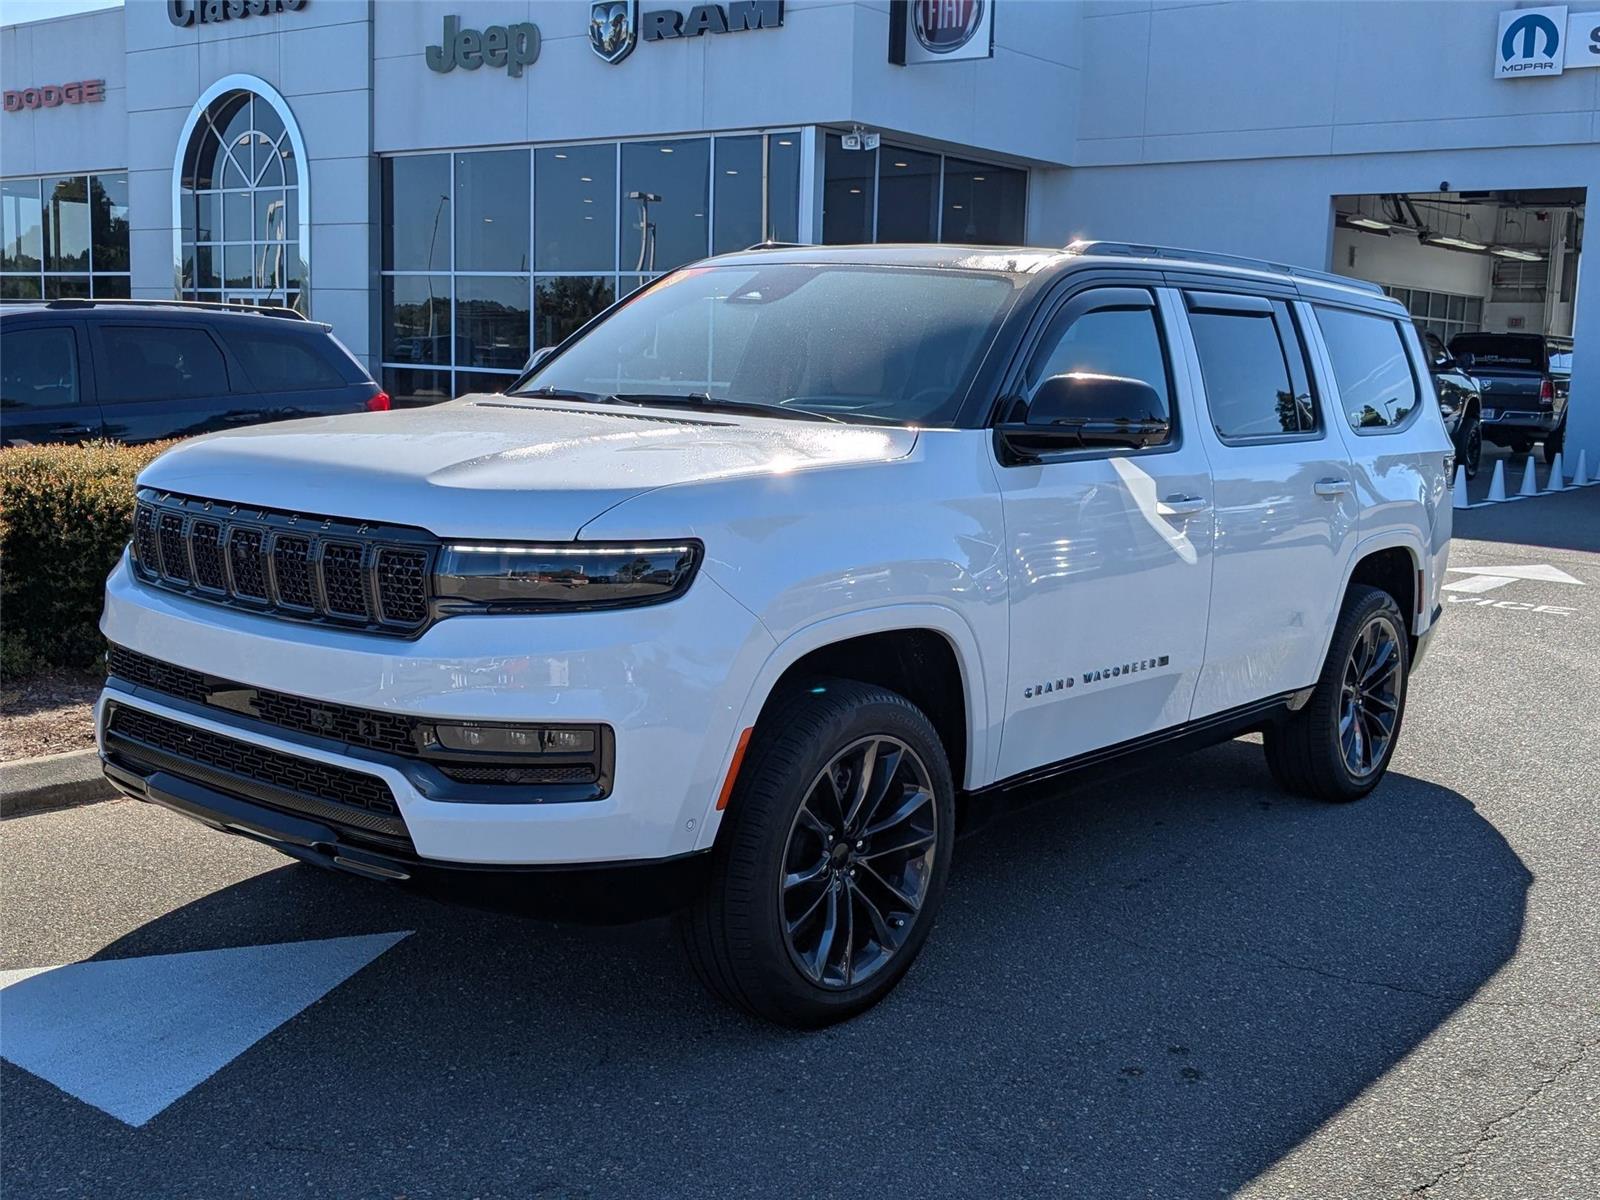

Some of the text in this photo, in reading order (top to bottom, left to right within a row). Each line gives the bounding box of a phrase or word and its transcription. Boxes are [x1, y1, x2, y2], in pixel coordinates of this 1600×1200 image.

[643, 1, 784, 41] RAM
[425, 15, 541, 78] Jeep
[1502, 62, 1554, 73] MOPAR
[3, 80, 105, 112] DODGE
[1024, 658, 1157, 699] GRAND WAGONEER
